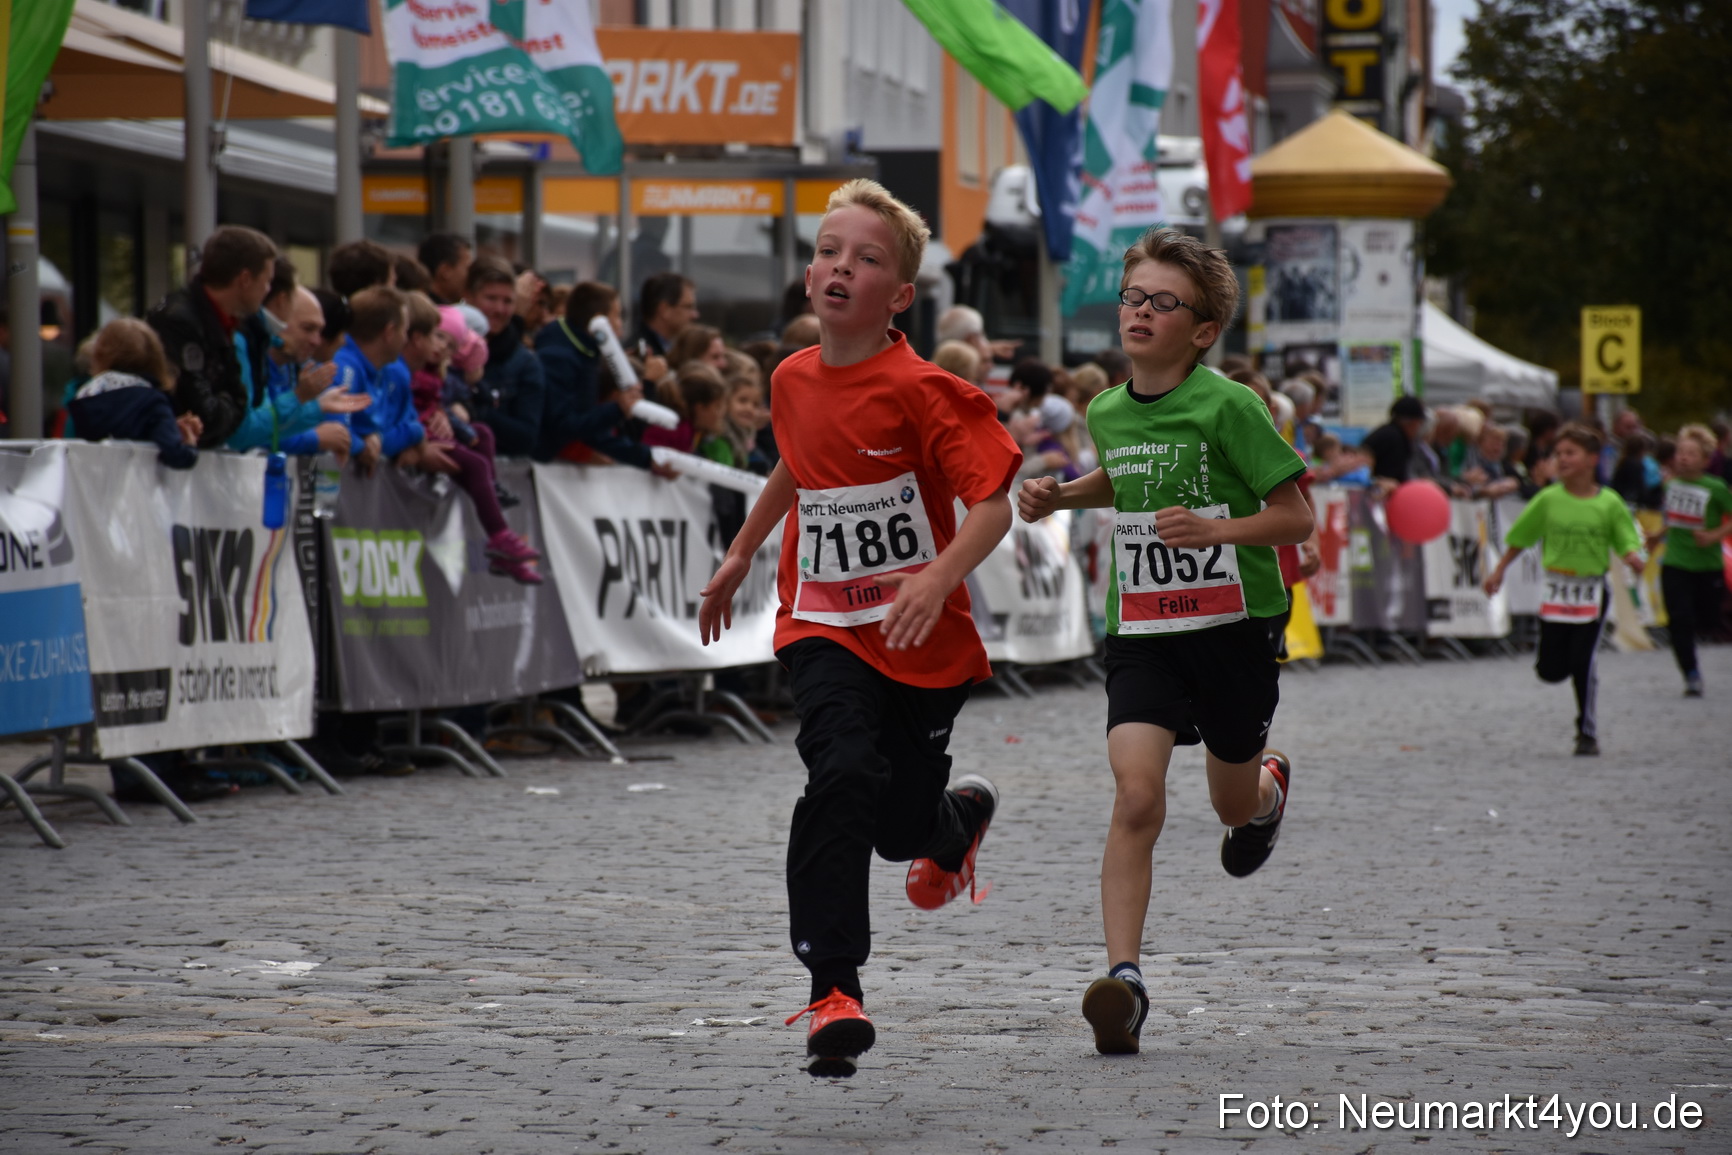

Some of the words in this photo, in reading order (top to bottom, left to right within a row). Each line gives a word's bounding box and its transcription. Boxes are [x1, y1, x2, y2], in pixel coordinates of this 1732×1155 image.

[1589, 313, 1633, 328] Block
[1596, 333, 1624, 374] C
[867, 446, 903, 457] Holzheim
[1106, 442, 1170, 461] Neumarkter
[1107, 459, 1154, 479] Stadtlauf
[1199, 442, 1214, 506] BAMBIN
[800, 503, 826, 517] PARTL
[828, 496, 897, 516] Neumarkt
[1116, 524, 1146, 536] PARTL
[806, 512, 919, 575] 7186
[333, 538, 426, 597] BOCK
[593, 517, 697, 620] PARTL
[1124, 541, 1227, 586] 7052
[842, 585, 882, 606] Tim
[1158, 595, 1200, 614] Felix
